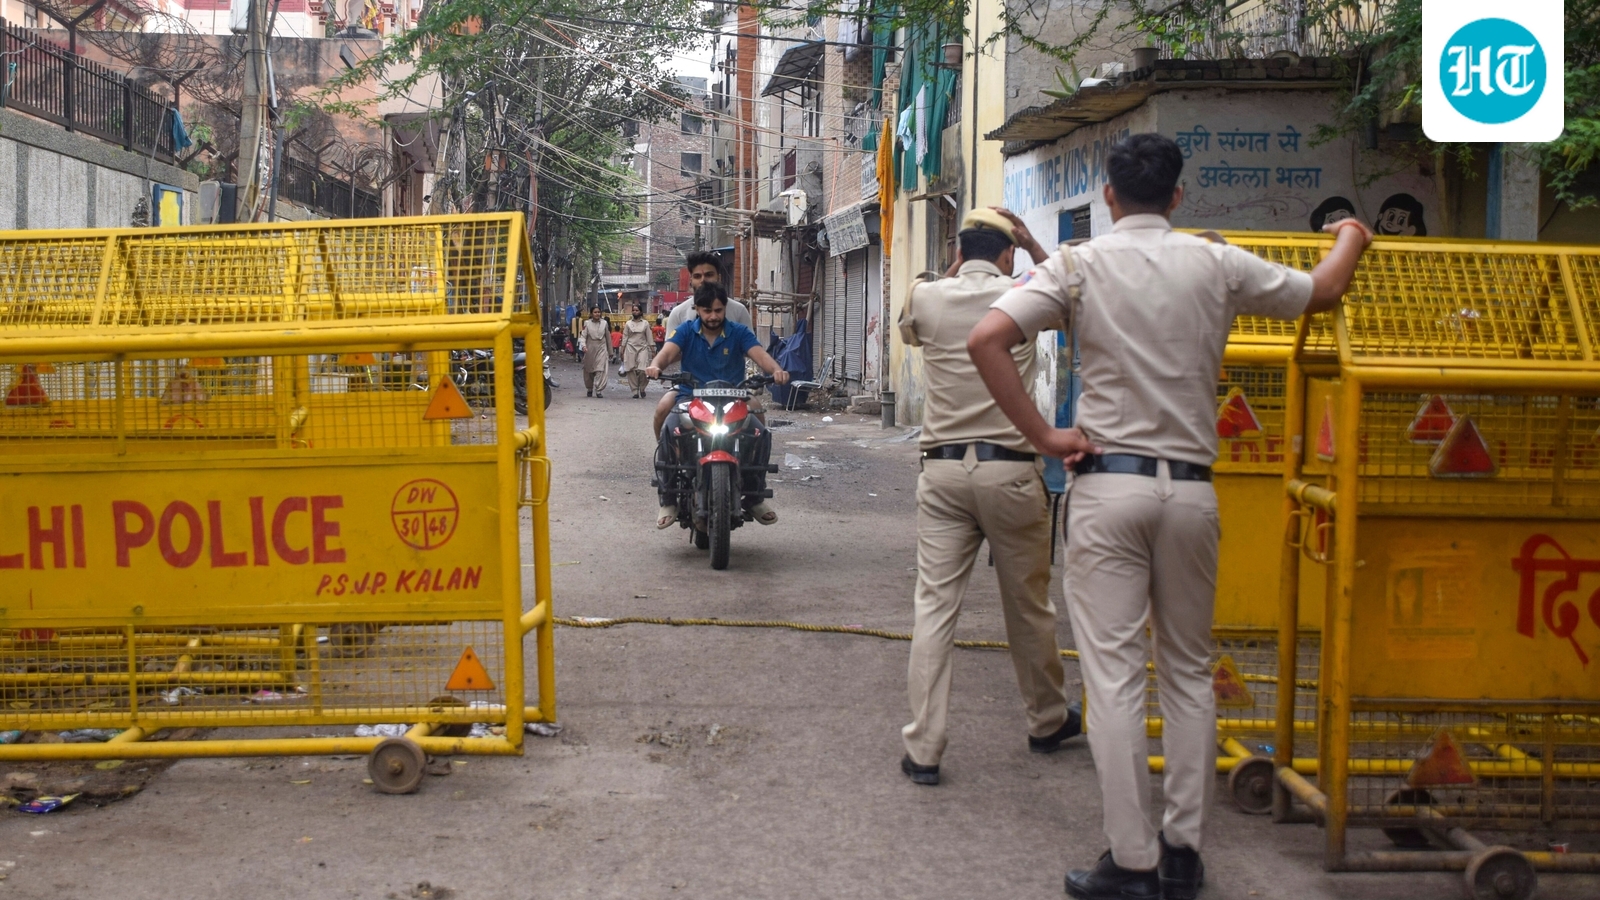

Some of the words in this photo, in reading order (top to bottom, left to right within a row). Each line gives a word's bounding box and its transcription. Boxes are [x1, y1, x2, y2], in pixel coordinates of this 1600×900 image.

[1175, 124, 1211, 160] बुरी
[1217, 127, 1270, 154] संगत
[1277, 124, 1301, 153] से
[1025, 155, 1061, 211] FUTURE
[1063, 144, 1088, 200] KIDS
[1197, 160, 1270, 188] अकेला
[1275, 166, 1322, 189] भला
[407, 486, 437, 504] DW
[112, 495, 347, 568] POLICE
[400, 516, 420, 537] 30
[428, 515, 448, 536] 48
[395, 565, 483, 594] KALAN
[1511, 533, 1600, 671] दि
